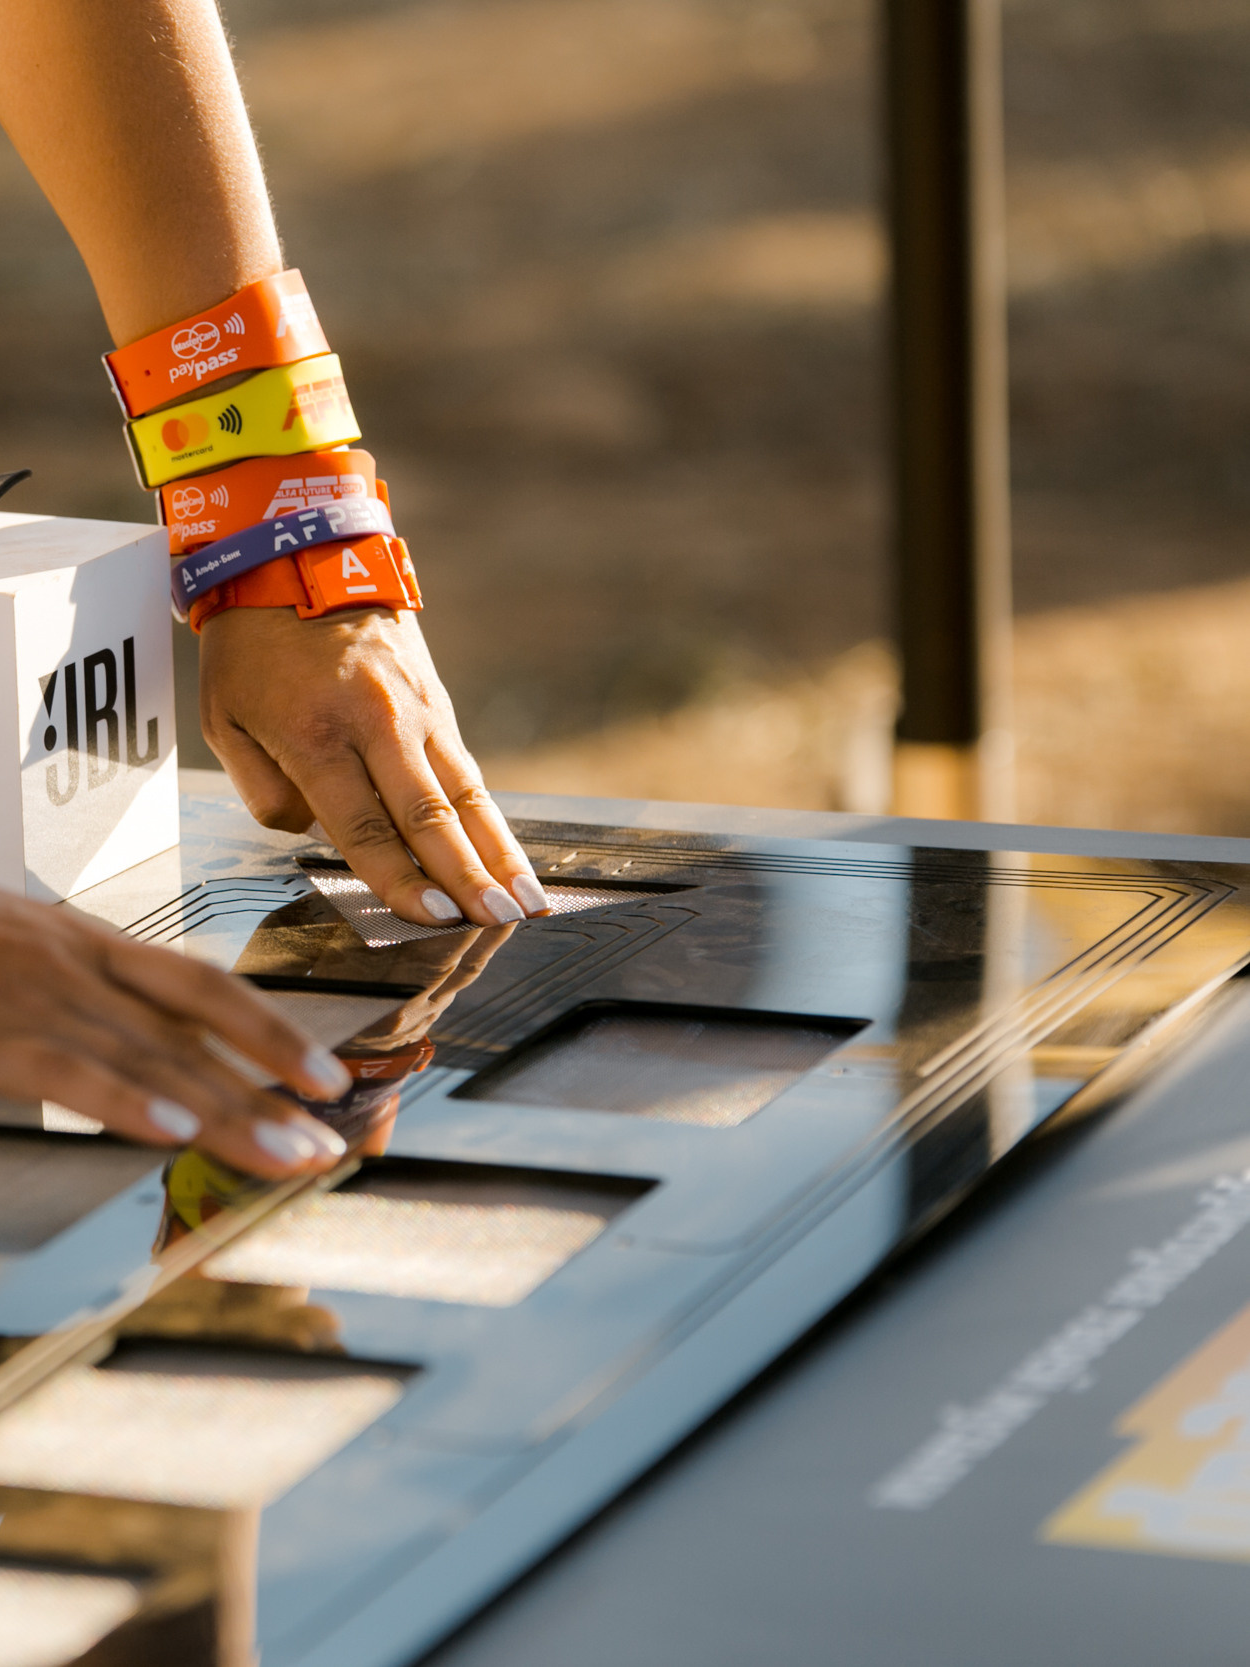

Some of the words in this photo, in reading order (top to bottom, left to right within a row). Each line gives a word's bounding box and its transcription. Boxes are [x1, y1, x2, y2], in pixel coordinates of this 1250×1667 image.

[173, 328, 218, 352] MasterCard
[168, 347, 239, 384] paypass
[170, 444, 214, 463] mastercard
[275, 489, 296, 498] ALFA
[299, 486, 331, 496] FUTURE
[273, 505, 347, 552] AFP
[45, 636, 160, 807] JBL
